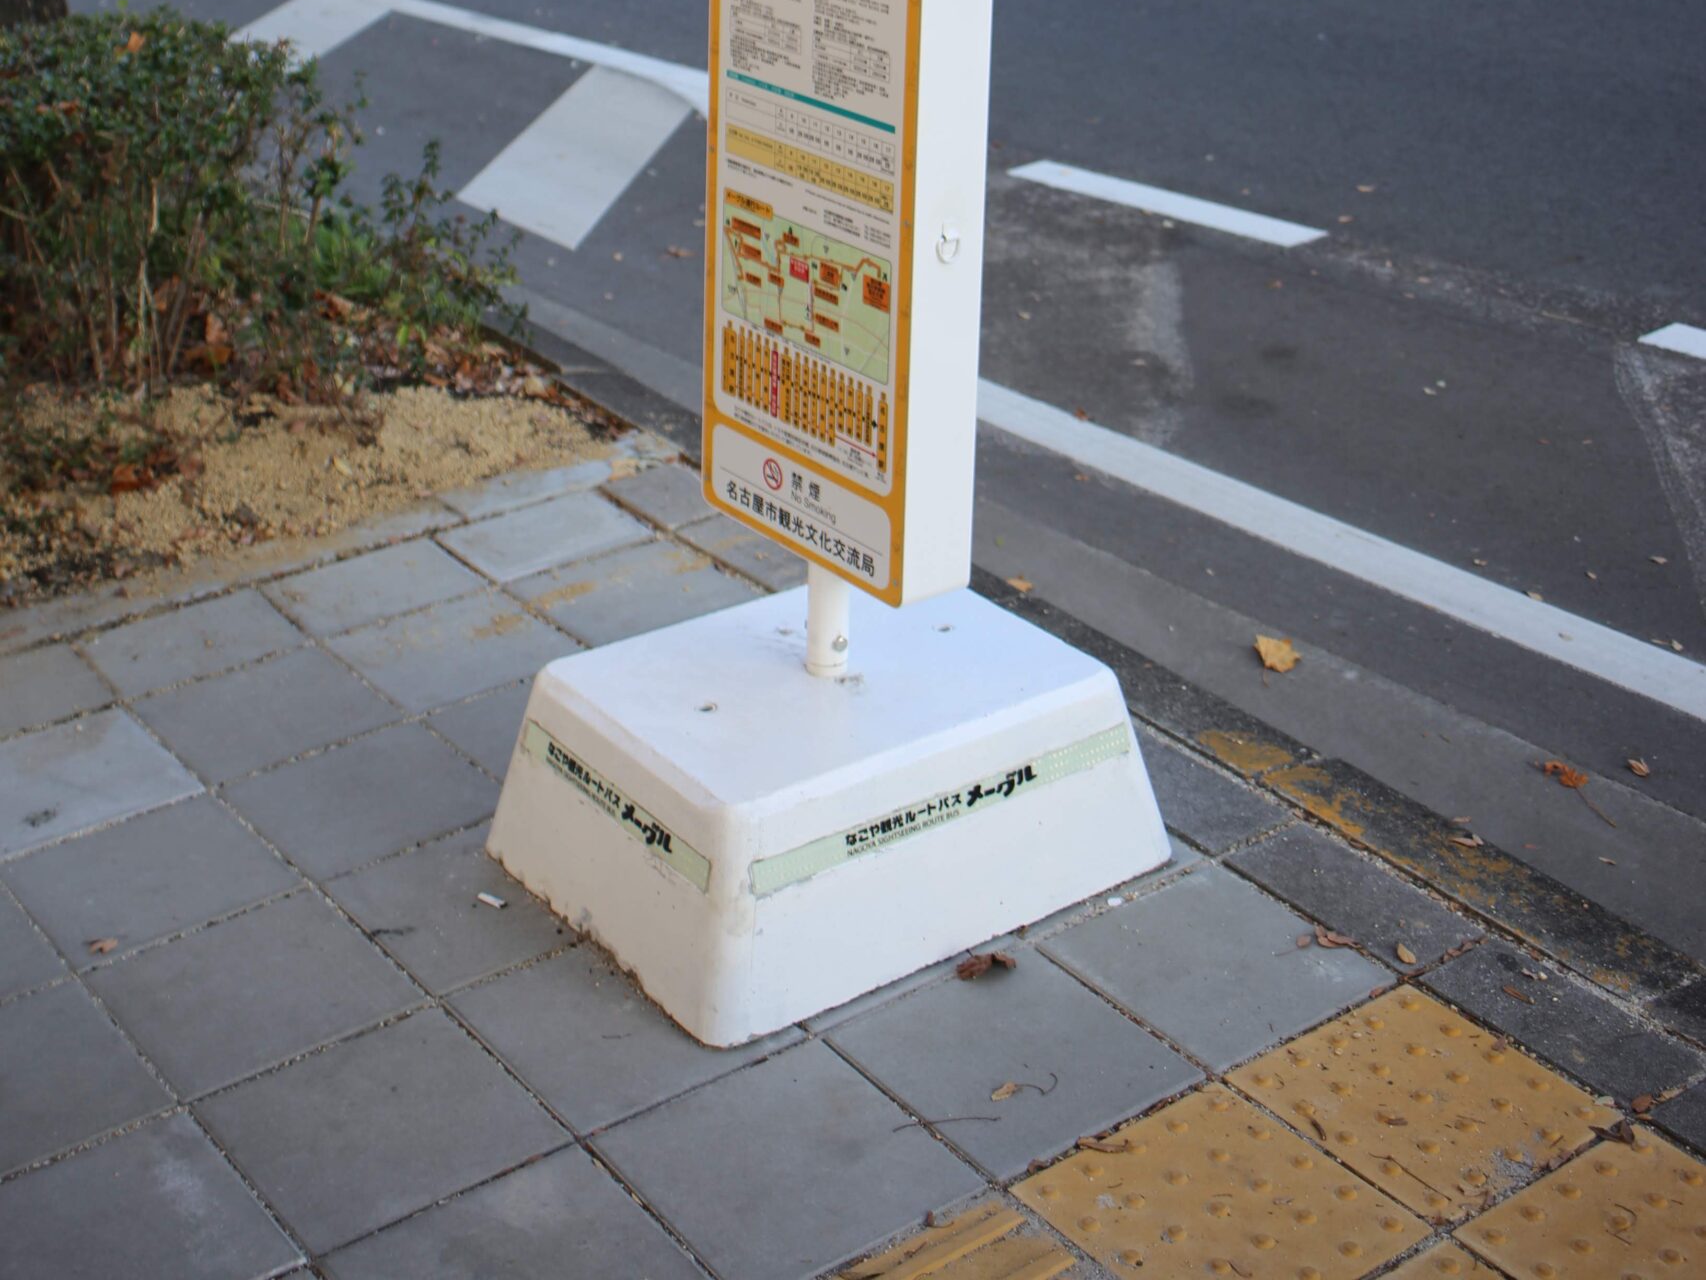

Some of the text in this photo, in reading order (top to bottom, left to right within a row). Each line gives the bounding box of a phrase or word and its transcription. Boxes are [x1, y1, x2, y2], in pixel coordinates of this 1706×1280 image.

[790, 471, 822, 502] 禁煙
[791, 490, 837, 525] No Smoking
[726, 480, 875, 578] 名古屋市観光文化交流局
[620, 801, 673, 854] メーグル
[845, 764, 1038, 846] なごや観光ルートバス メーグル
[846, 840, 877, 857] NAGOYA
[922, 814, 946, 829] ROUTE
[946, 809, 960, 821] BUS
